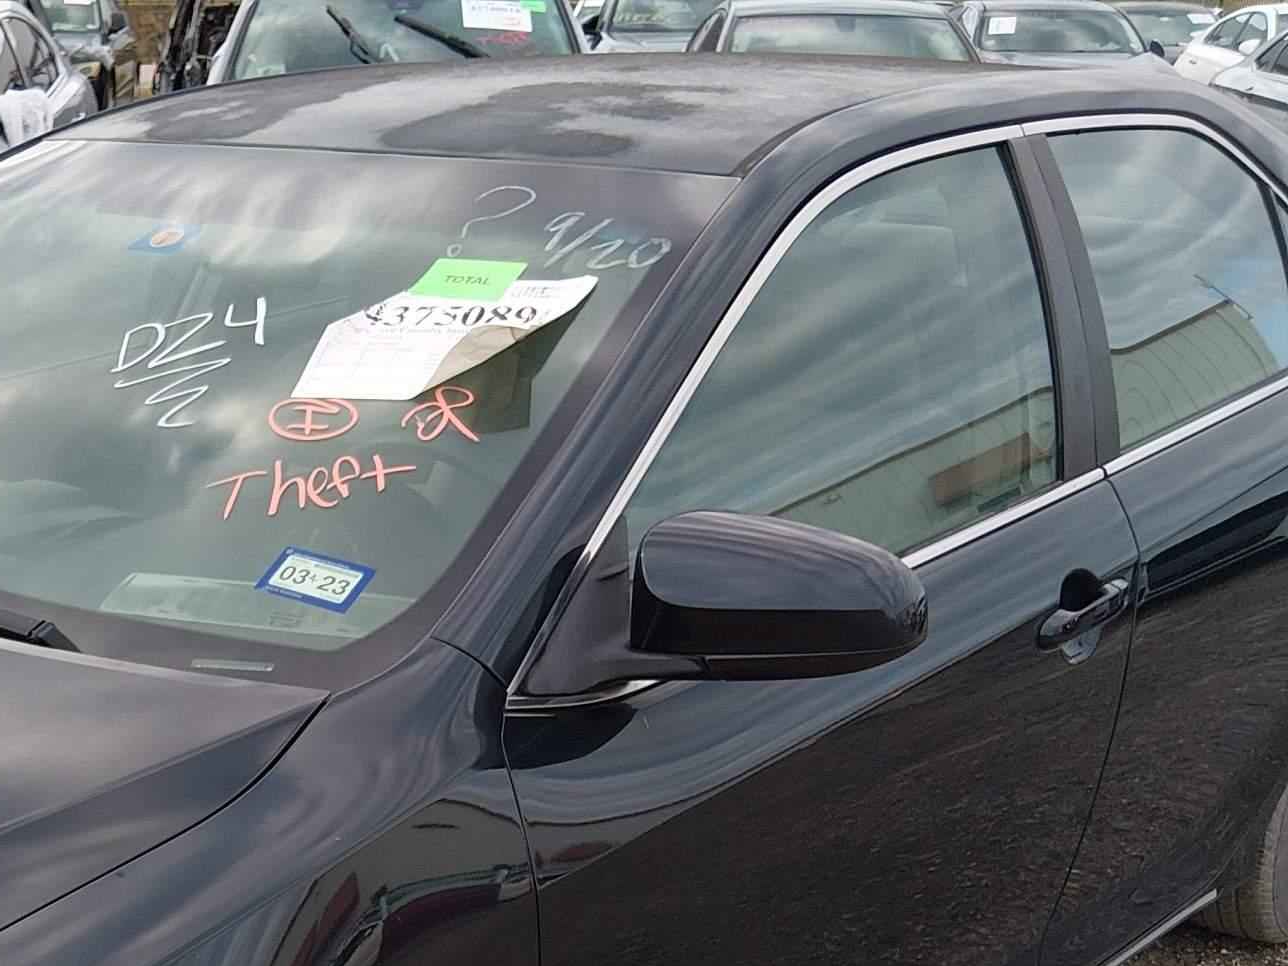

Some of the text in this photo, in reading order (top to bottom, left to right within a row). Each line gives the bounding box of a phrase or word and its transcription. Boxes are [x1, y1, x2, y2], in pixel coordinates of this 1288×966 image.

[544, 211, 672, 269] 9/20
[444, 274, 491, 286] TOTAL
[204, 454, 417, 520] Theft
[279, 565, 311, 585] 03
[316, 575, 351, 596] 23
